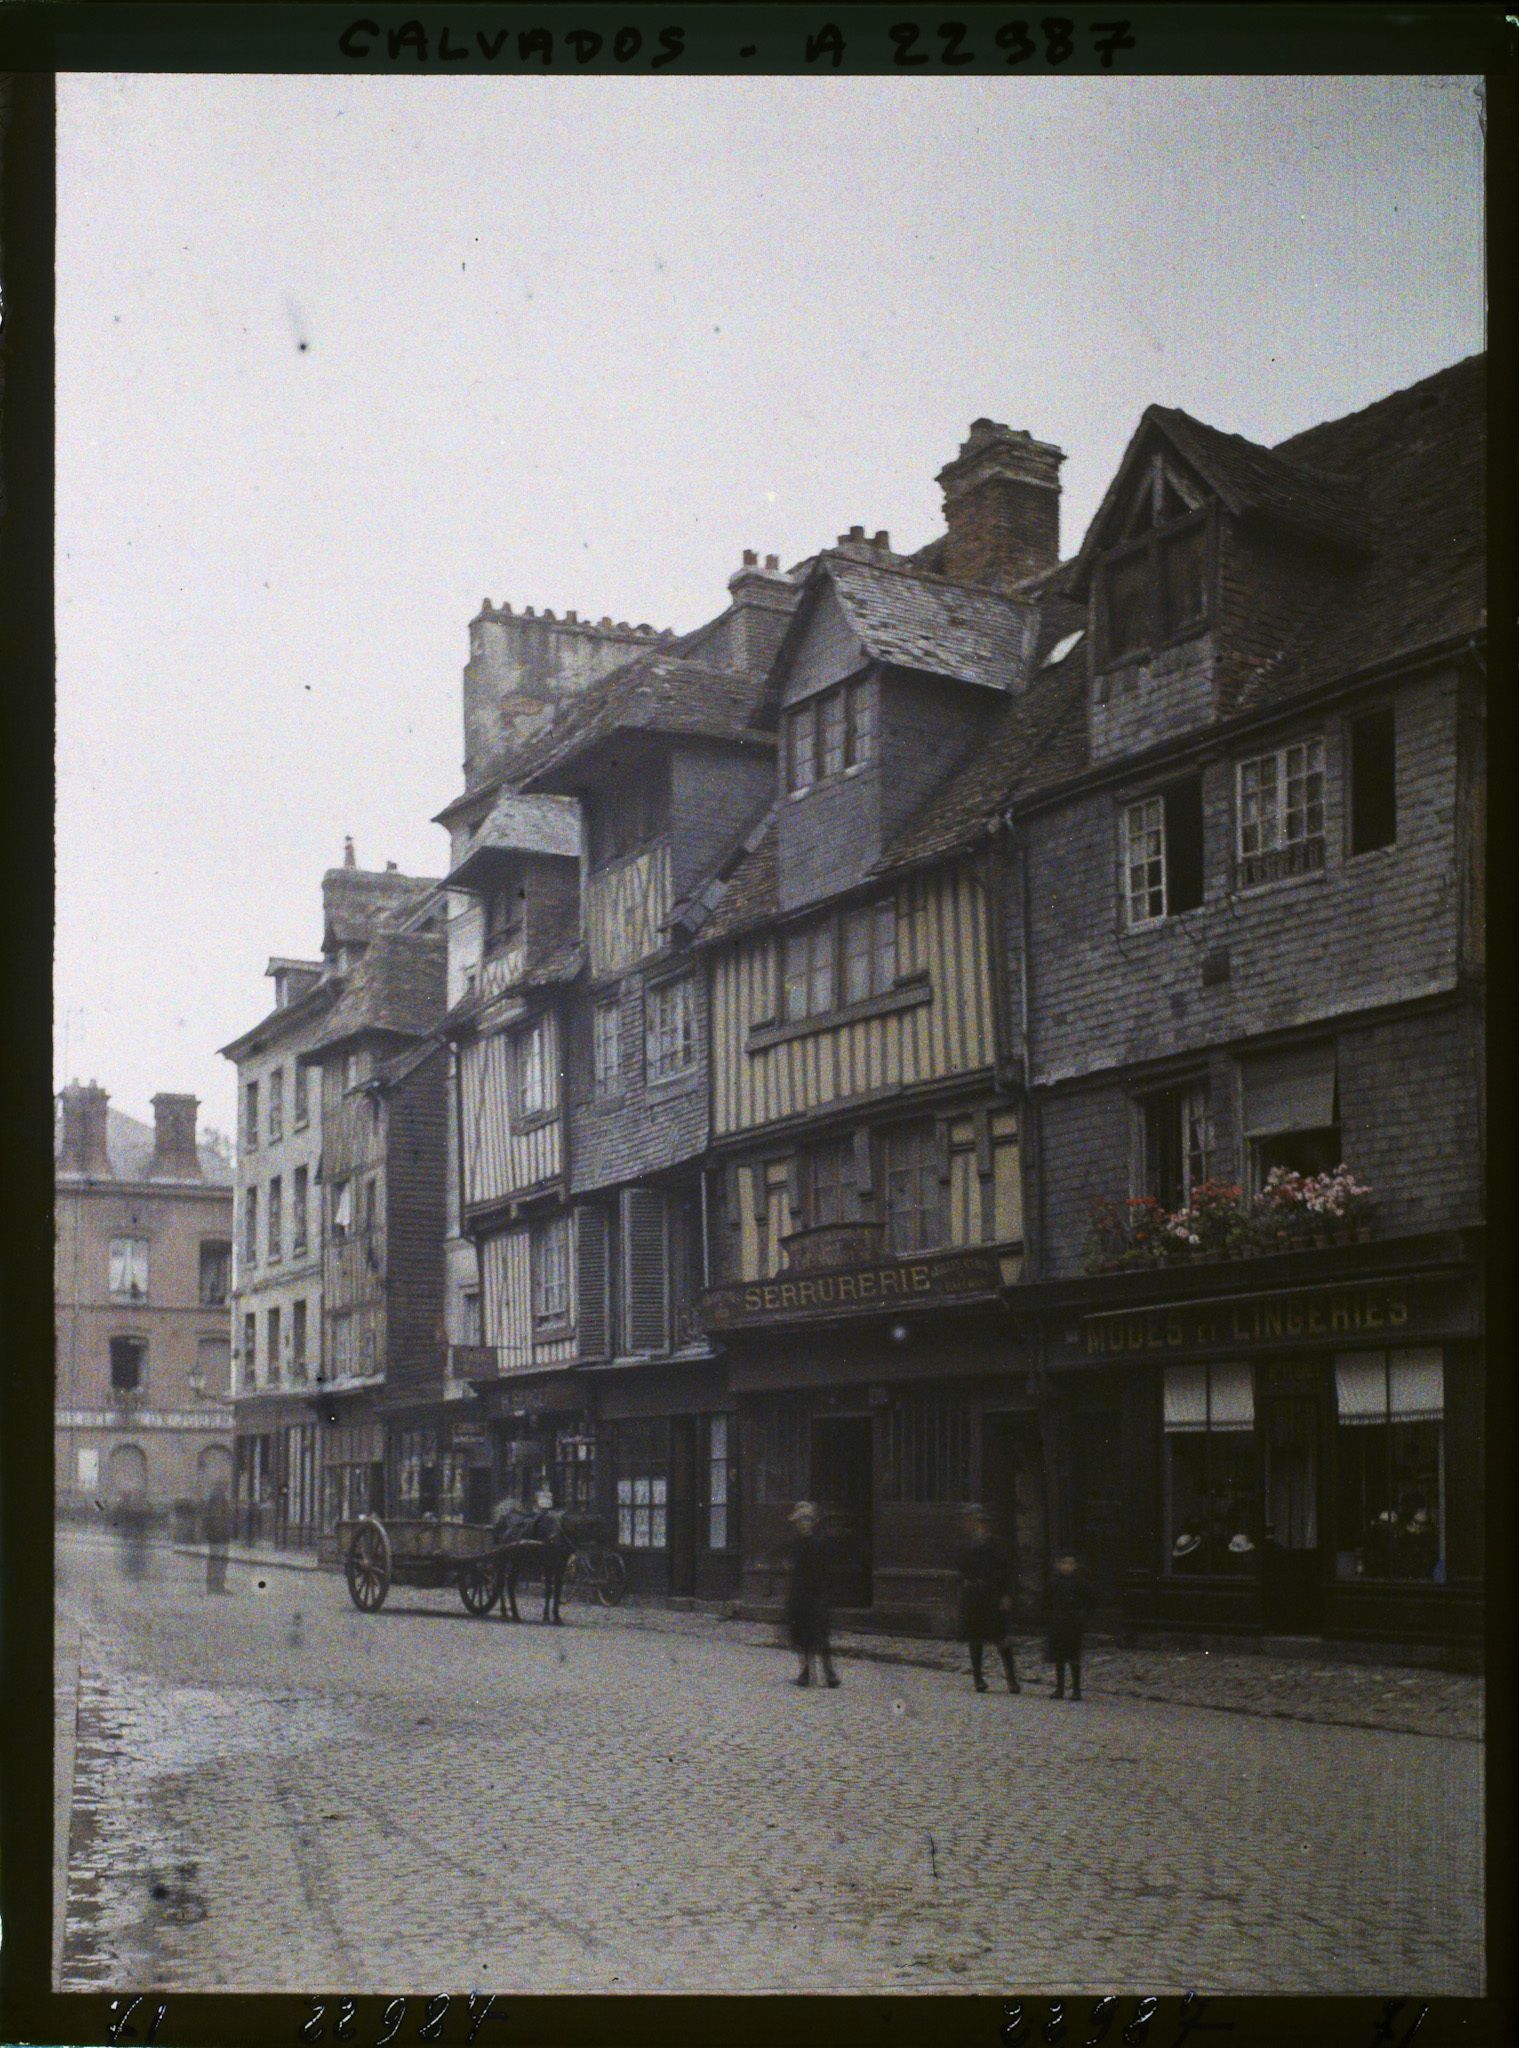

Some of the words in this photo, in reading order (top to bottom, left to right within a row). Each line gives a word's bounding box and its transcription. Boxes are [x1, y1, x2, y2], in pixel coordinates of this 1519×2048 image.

[339, 19, 686, 68] CALVADOS
[805, 22, 847, 67] A
[888, 17, 1136, 66] 22987
[744, 1265, 931, 1312] SERRURERIE
[1086, 1311, 1184, 1354] MODES
[1232, 1294, 1409, 1342] LINGERIES
